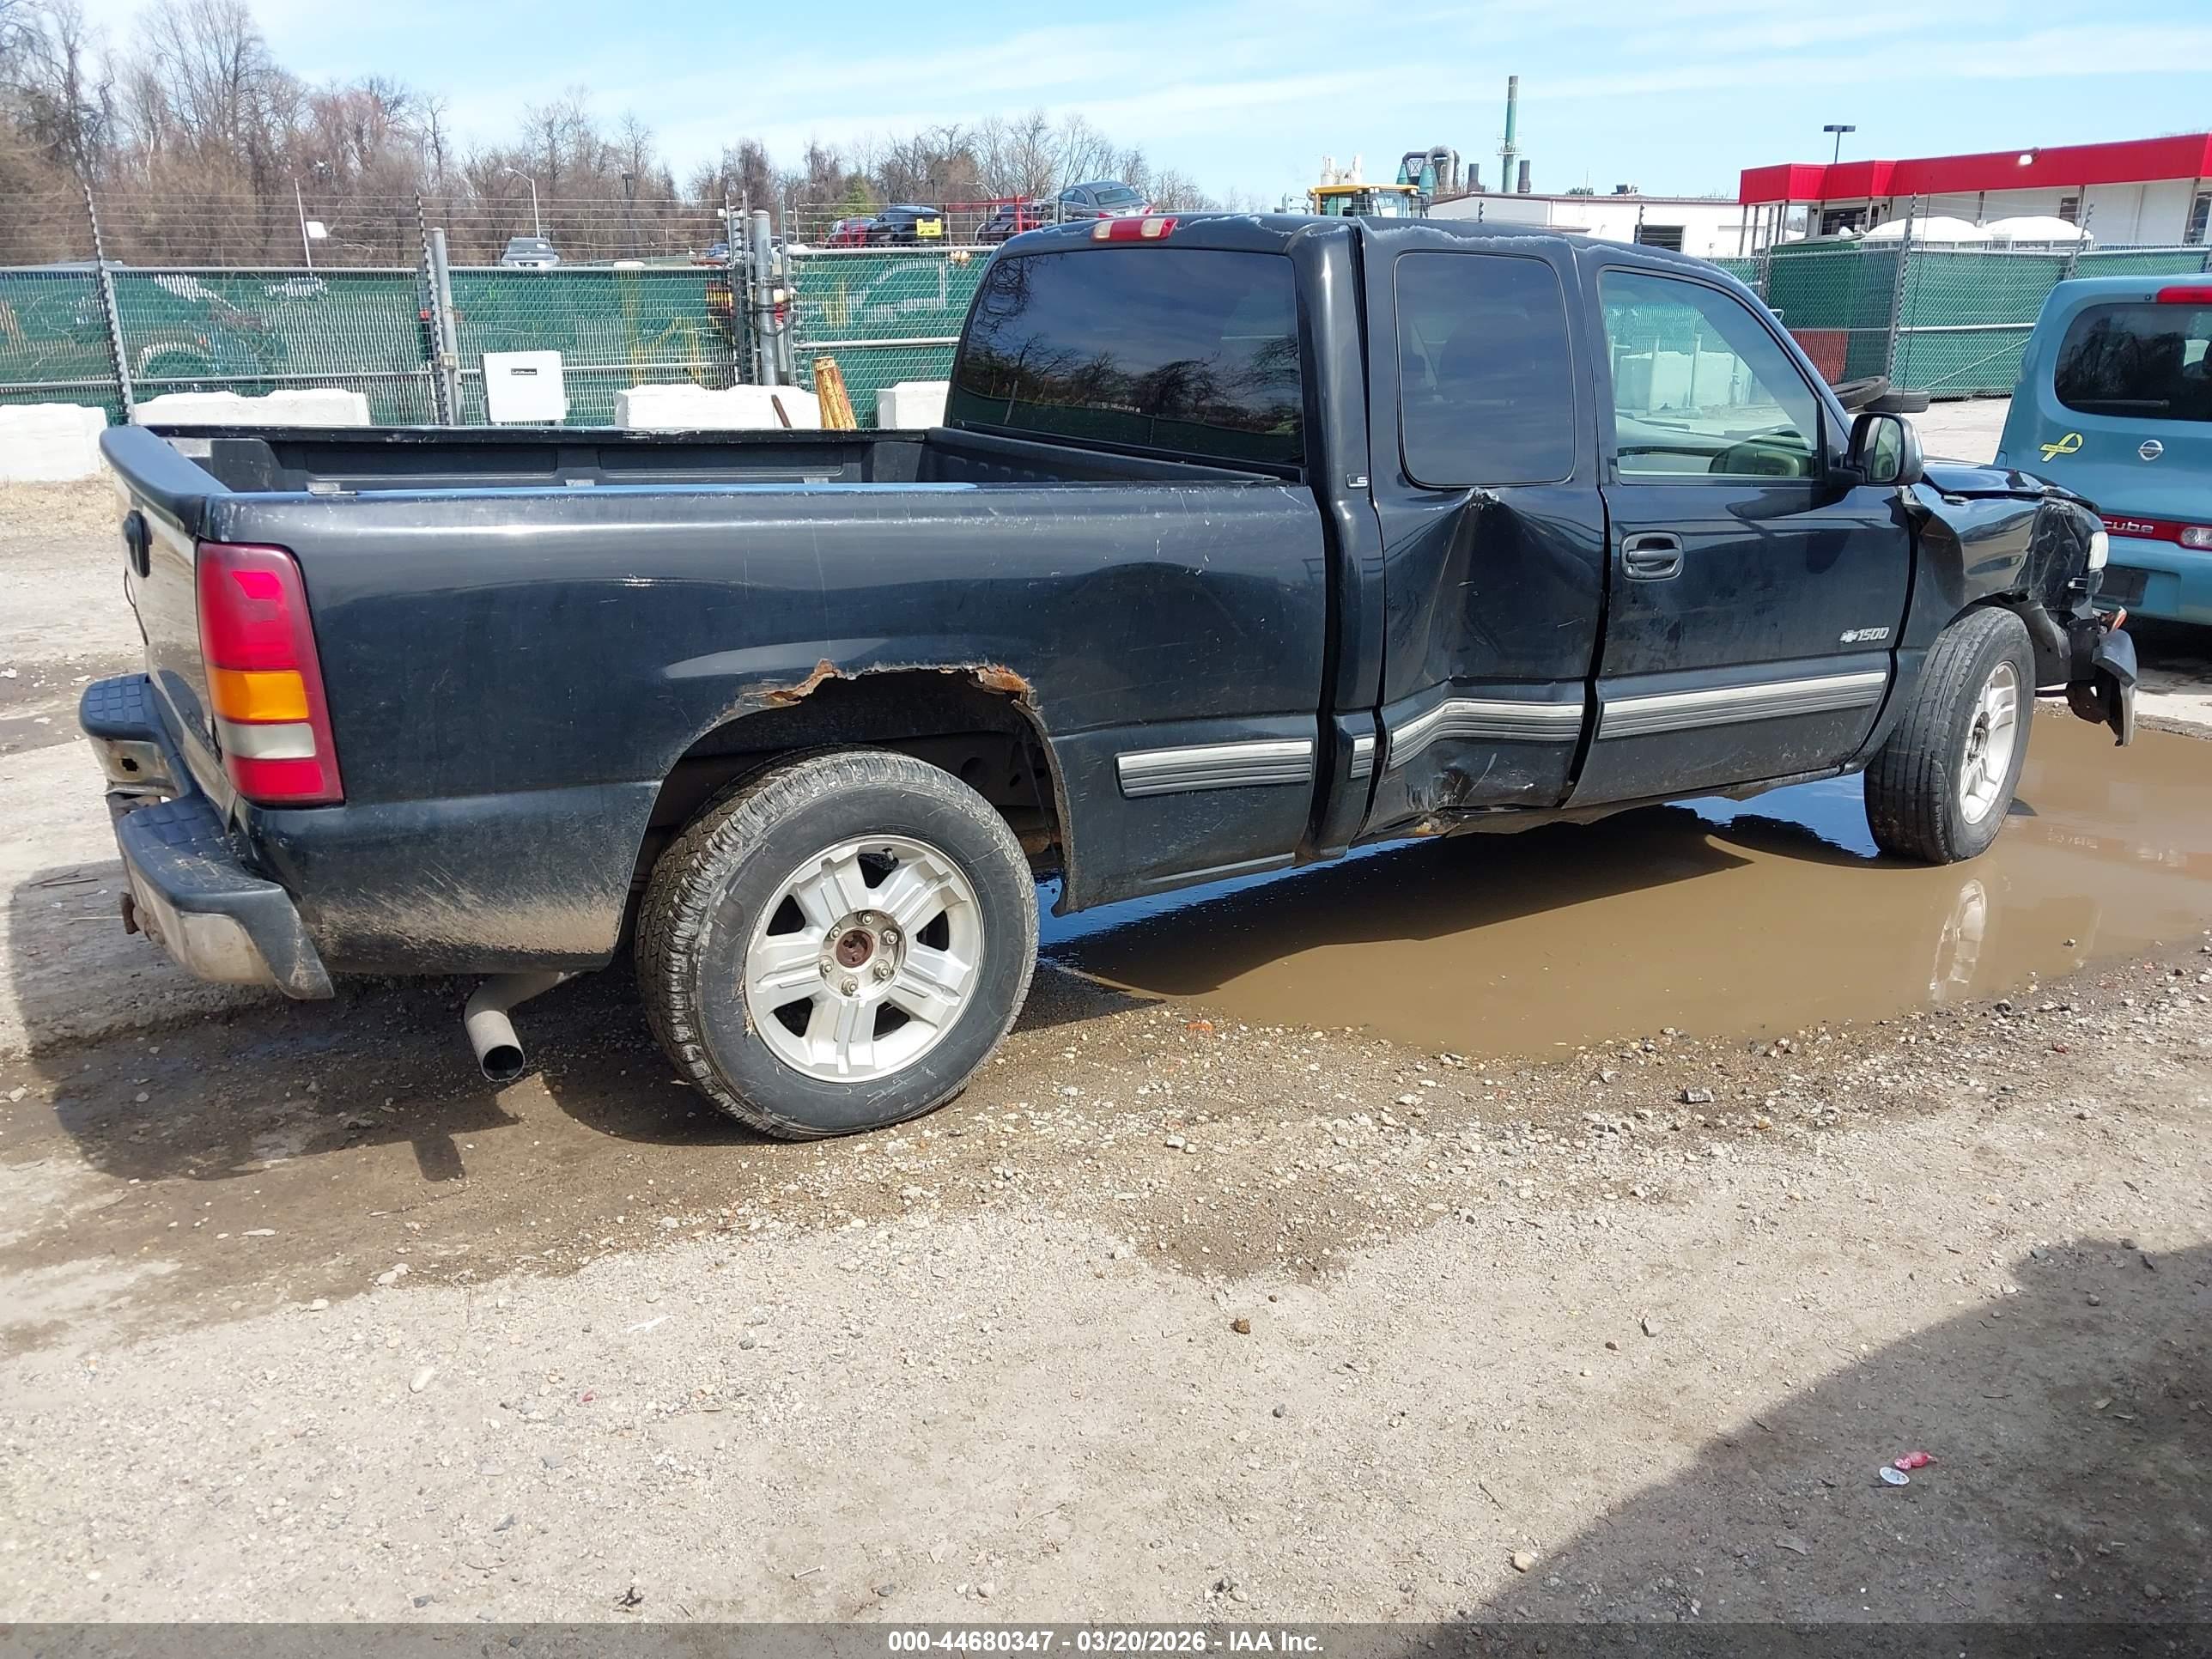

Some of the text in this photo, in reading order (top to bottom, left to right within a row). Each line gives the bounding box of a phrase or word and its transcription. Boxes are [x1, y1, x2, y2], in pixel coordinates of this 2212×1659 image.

[1346, 474, 1368, 488] LS
[2103, 520, 2154, 533] cube
[1856, 627, 1889, 641] 1500
